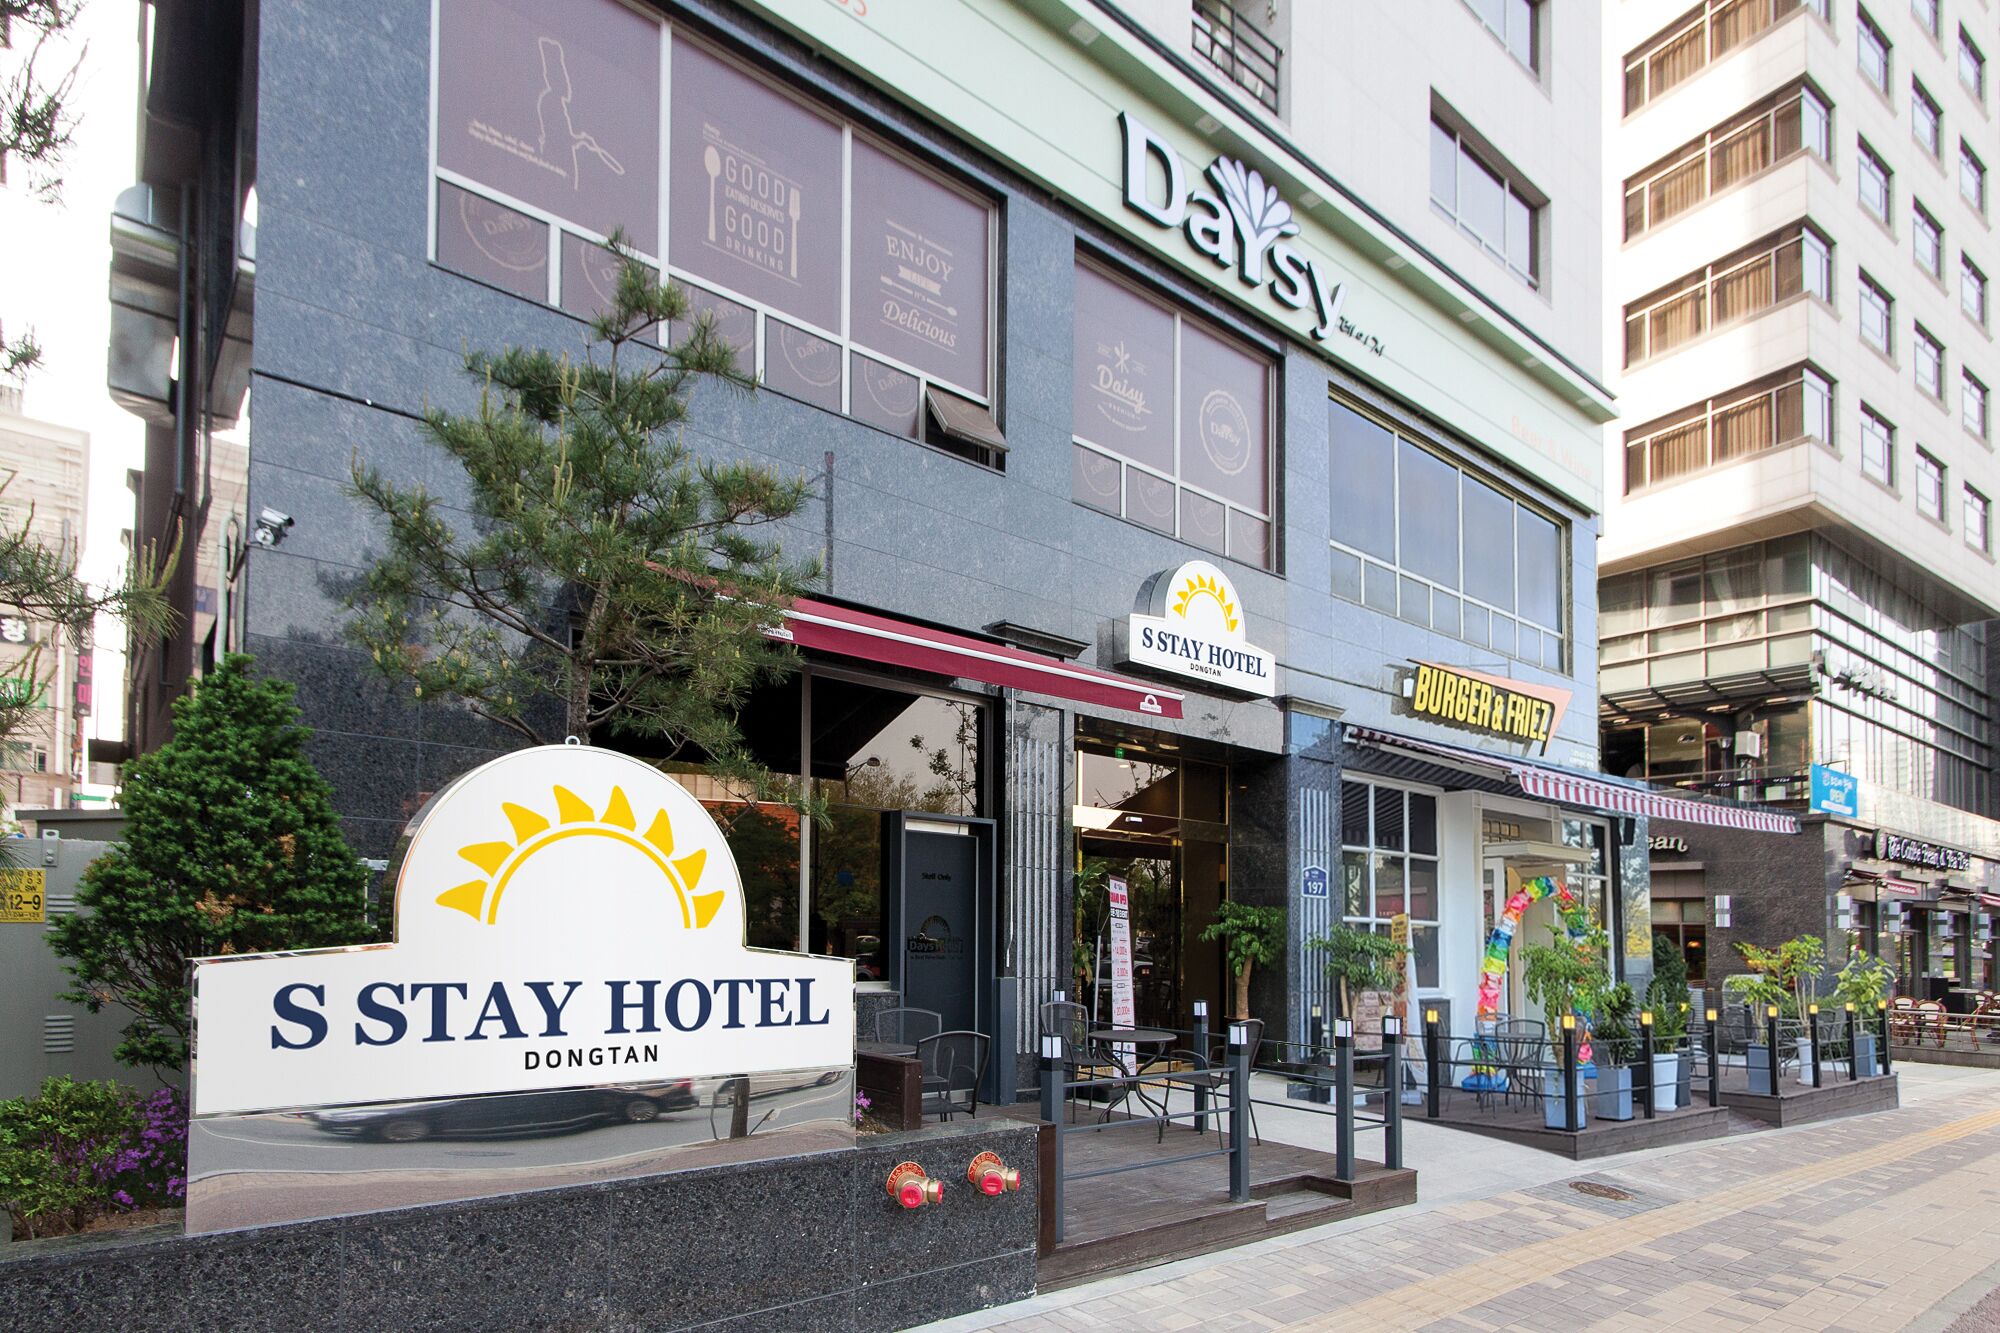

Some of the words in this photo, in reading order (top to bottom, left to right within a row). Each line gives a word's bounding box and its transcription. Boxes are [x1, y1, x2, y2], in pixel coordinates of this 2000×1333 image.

[725, 155, 784, 207] GOOD
[725, 184, 750, 209] EATING
[725, 205, 784, 255] GOOD
[726, 235, 783, 272] DRINKING
[885, 234, 954, 282] ENJOY
[882, 300, 957, 347] Delicious
[1096, 363, 1146, 414] Daisy
[1142, 627, 1154, 649] S
[1157, 630, 1204, 661] STAY
[1208, 644, 1267, 678] HOTEL
[1190, 662, 1222, 677] DONGTAN
[1413, 665, 1493, 727] BURGER
[1491, 694, 1504, 732] &
[1504, 692, 1550, 742] FRIEZ
[937, 873, 952, 882] Only
[1307, 880, 1323, 894] 197
[910, 940, 934, 951] Days
[271, 982, 329, 1050] S
[354, 980, 583, 1046] STAY
[604, 977, 830, 1035] HOTEL
[524, 1044, 660, 1071] DONGTAN
